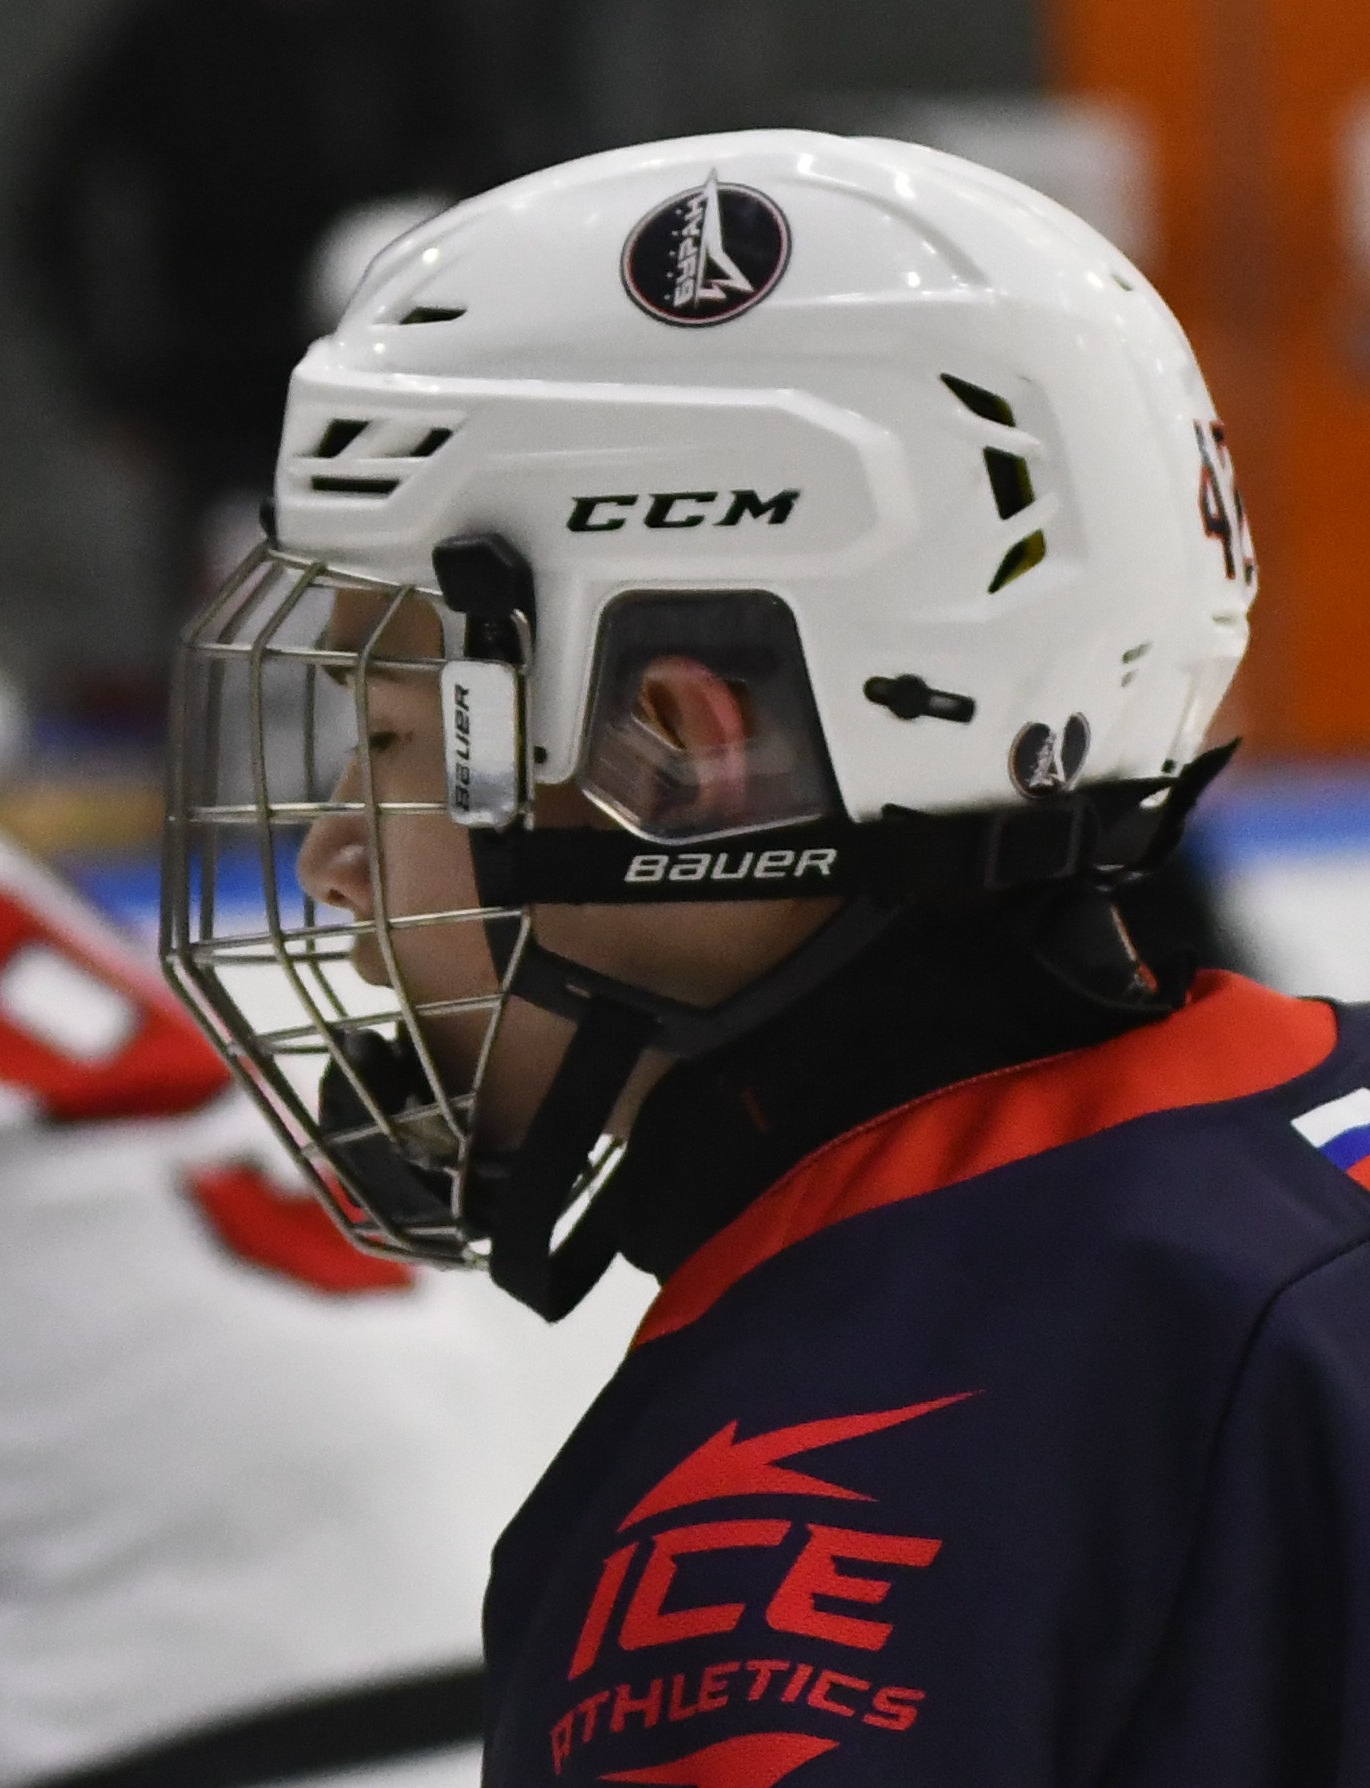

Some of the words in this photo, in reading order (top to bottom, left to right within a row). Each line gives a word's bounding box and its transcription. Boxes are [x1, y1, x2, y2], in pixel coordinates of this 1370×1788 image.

[567, 489, 801, 533] CCM
[624, 848, 837, 883] BAUER
[568, 1519, 943, 1681] ICE
[551, 1659, 926, 1776] ATHLETICS
